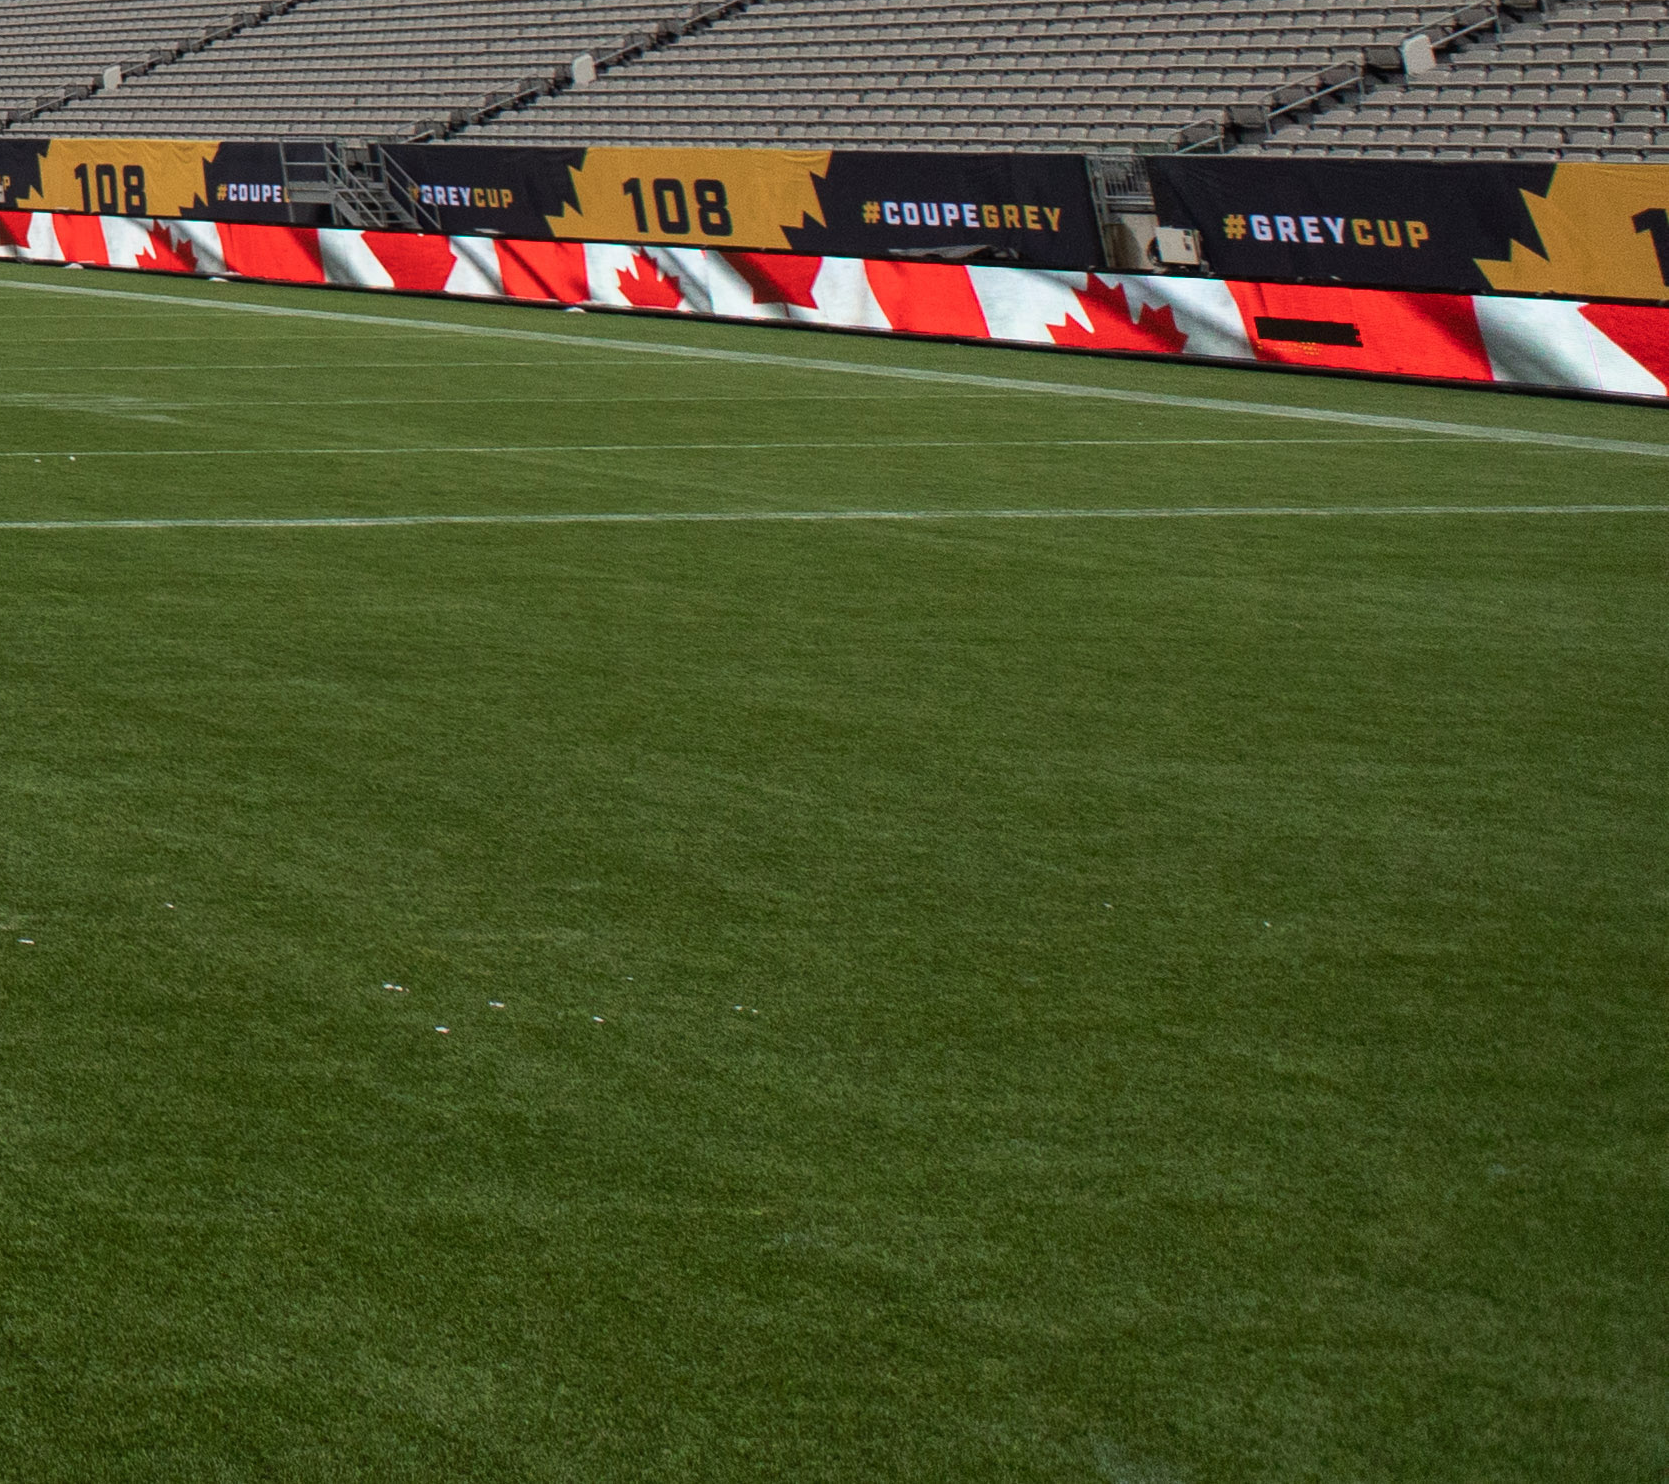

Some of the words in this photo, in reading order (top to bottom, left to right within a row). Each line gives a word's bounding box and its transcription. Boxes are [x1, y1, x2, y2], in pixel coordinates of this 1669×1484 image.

[74, 163, 148, 215] 108
[407, 183, 514, 209] #GREYCUP
[622, 177, 733, 237] 108
[861, 200, 1062, 233] #COUPEGREY
[1223, 212, 1430, 250] #GREYCUP
